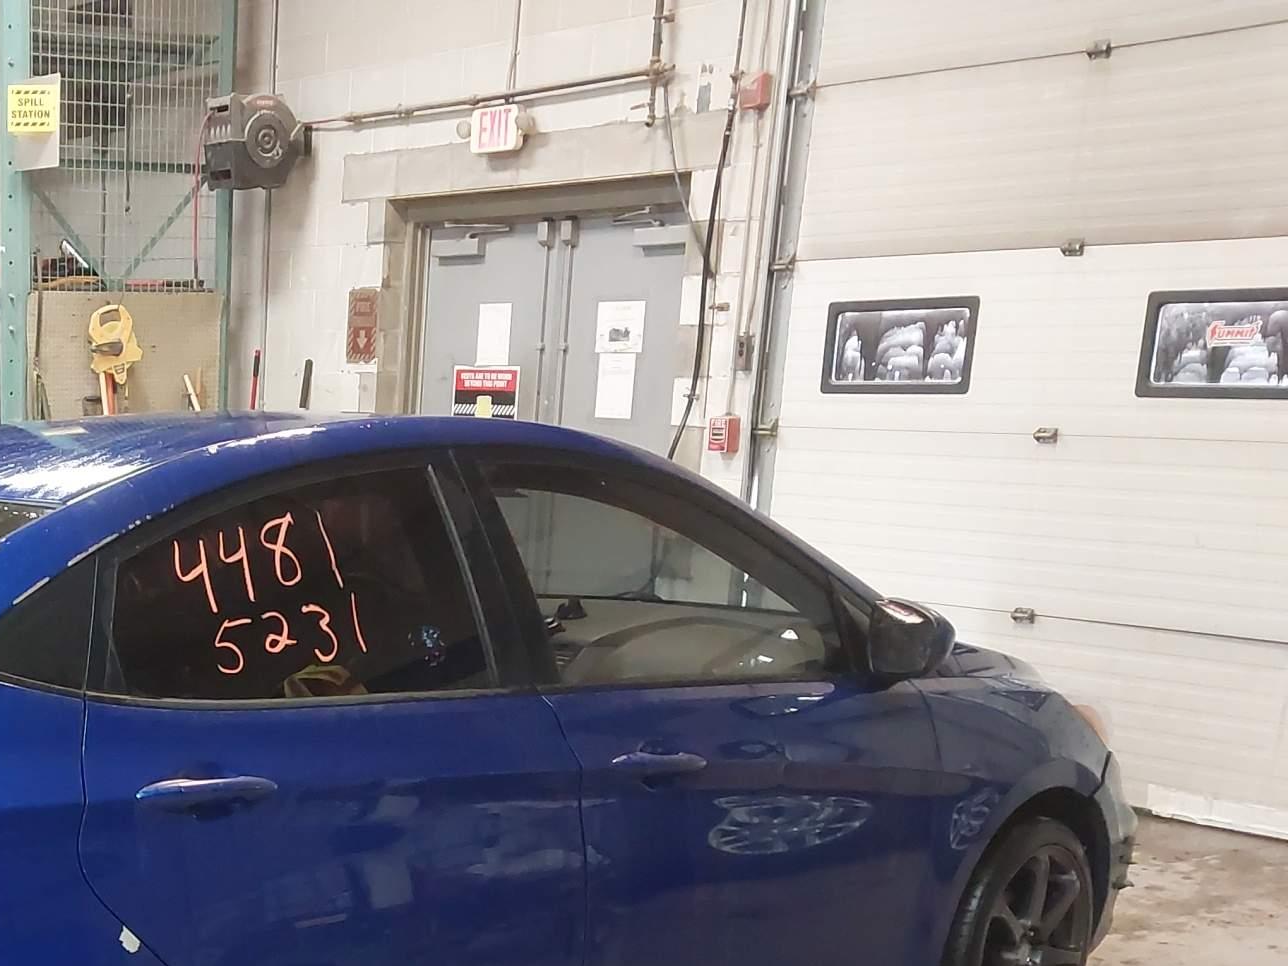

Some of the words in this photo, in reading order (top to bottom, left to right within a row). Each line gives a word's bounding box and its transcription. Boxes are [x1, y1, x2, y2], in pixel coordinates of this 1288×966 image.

[11, 110, 50, 119] STATION
[17, 97, 44, 107] SPILL
[478, 107, 512, 149] EXIT
[173, 511, 344, 613] 4481
[214, 592, 367, 674] 5231
